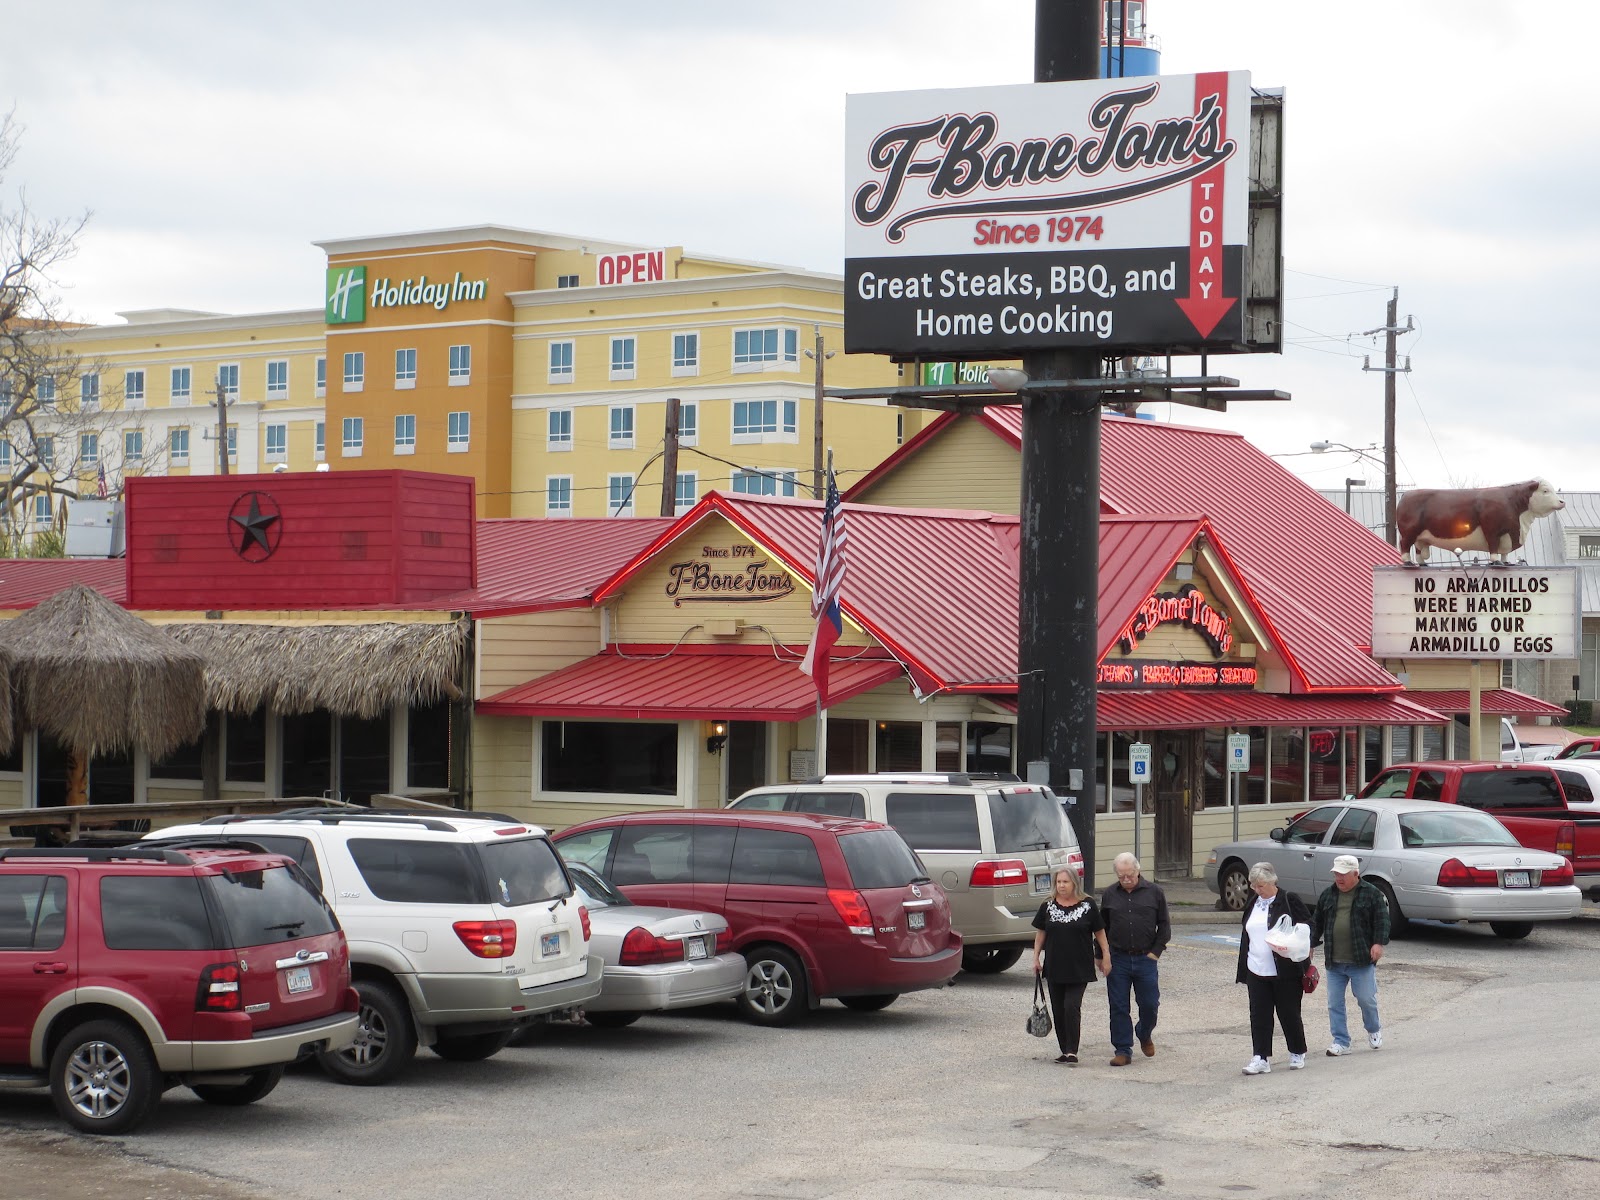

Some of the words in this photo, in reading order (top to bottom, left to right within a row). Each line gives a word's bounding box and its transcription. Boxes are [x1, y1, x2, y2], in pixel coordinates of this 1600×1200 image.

[1075, 82, 1237, 173] Tom's
[974, 219, 1039, 246] Since
[1046, 215, 1104, 243] 1974
[1198, 183, 1215, 299] TODAY
[599, 251, 663, 286] OPEN
[858, 271, 933, 300] Great
[939, 268, 1043, 300] Steaks,
[1050, 264, 1117, 299] BBQ,
[1125, 261, 1177, 292] and
[370, 275, 450, 310] Holiday
[451, 271, 485, 301] Inn
[915, 308, 993, 336] Home
[1000, 305, 1114, 338] Cooking
[702, 546, 730, 558] Since
[731, 544, 756, 558] 1974
[744, 559, 796, 593] Tom's
[1414, 577, 1436, 593] NO
[1446, 577, 1549, 593] ARMADILLOS
[1414, 597, 1458, 613] WERE
[1466, 597, 1532, 613] HARMED
[1415, 617, 1478, 632] MAKING
[1490, 617, 1525, 633] OUR
[1409, 636, 1500, 652] ARMADILLO
[1513, 637, 1553, 653] EGGS
[1310, 735, 1332, 752] OPEN
